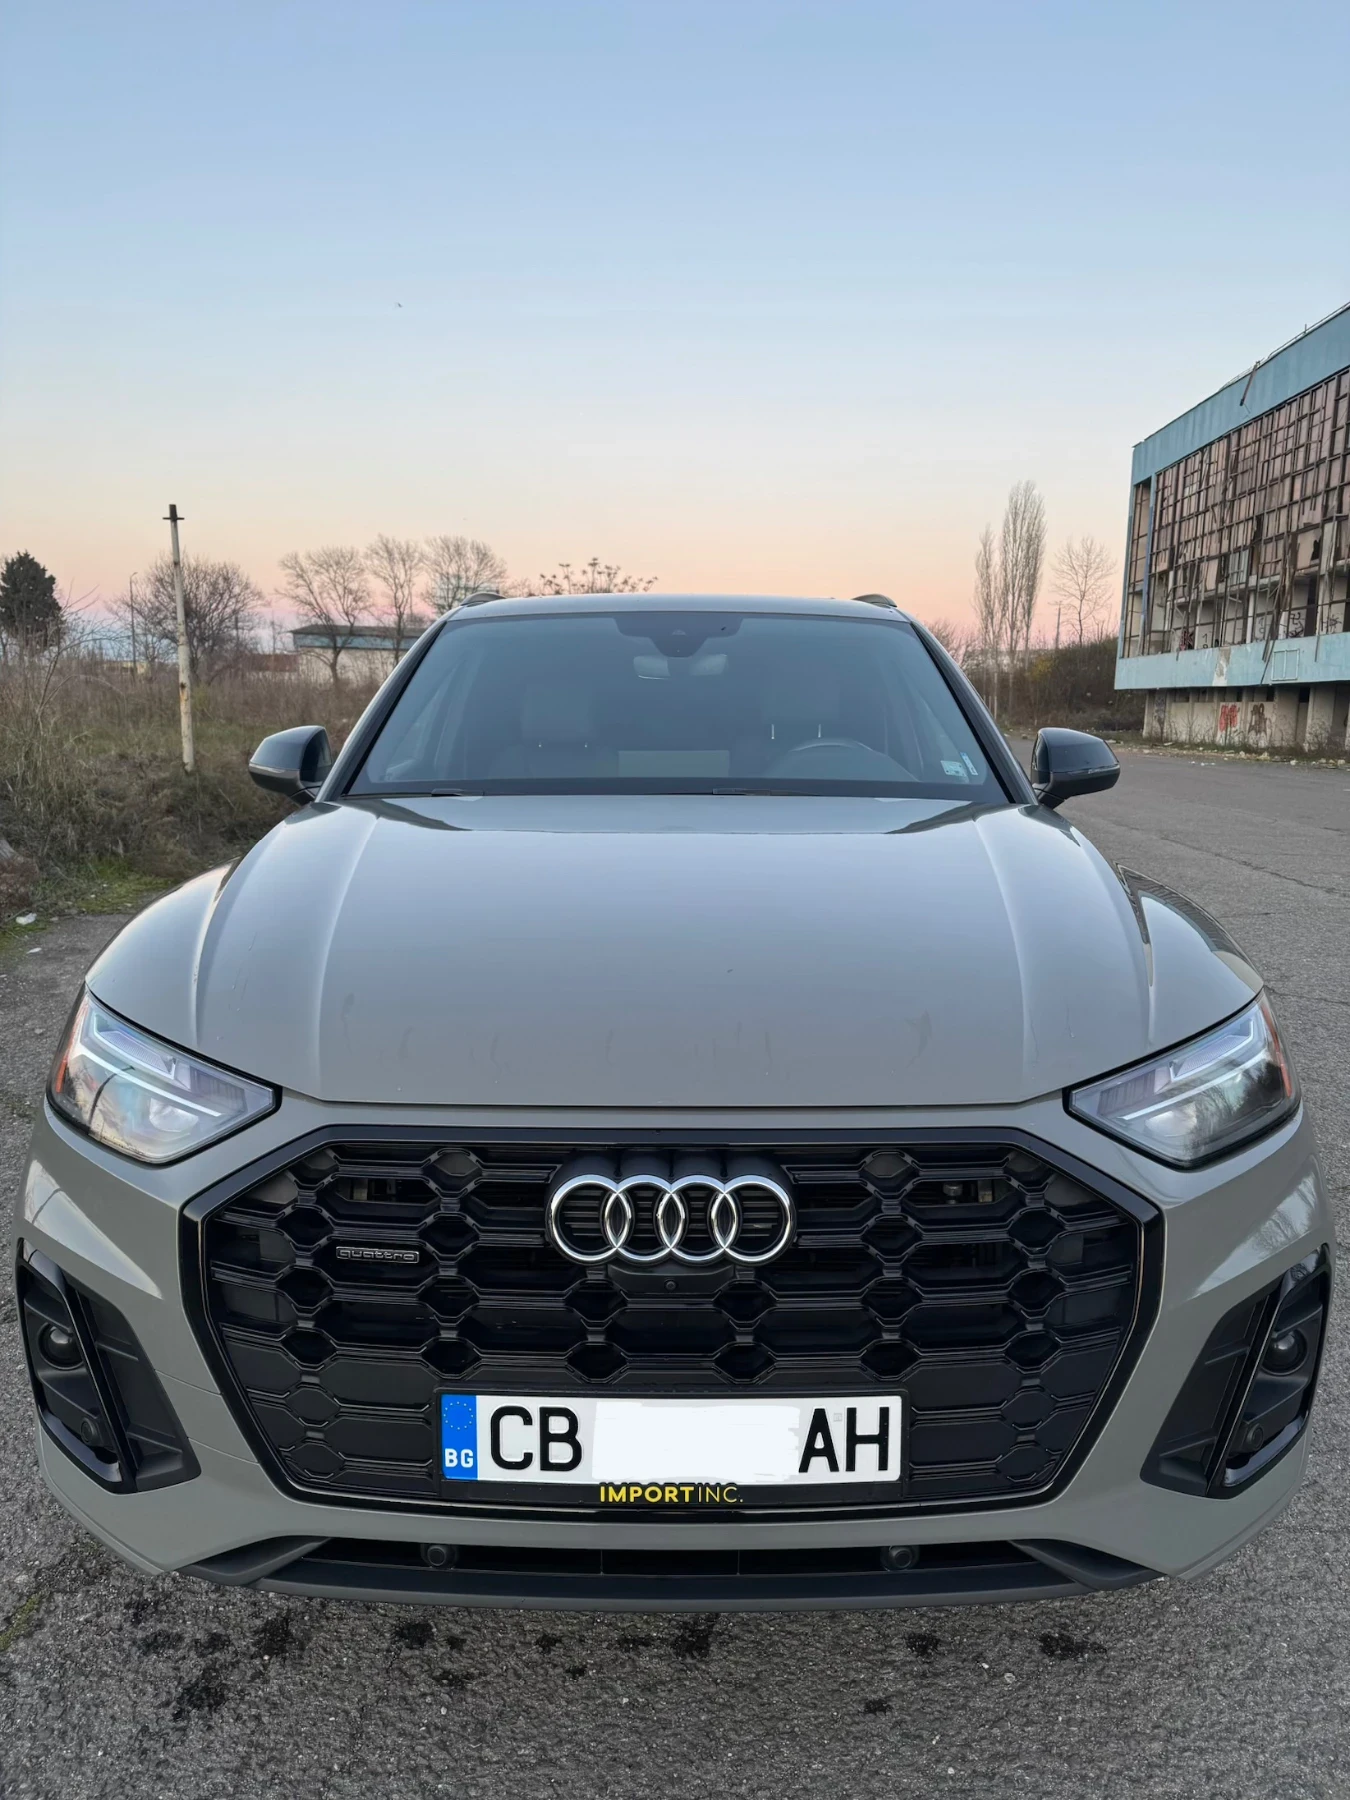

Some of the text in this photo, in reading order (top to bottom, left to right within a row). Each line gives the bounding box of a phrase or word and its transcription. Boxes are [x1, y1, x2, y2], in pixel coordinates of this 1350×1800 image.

[339, 1249, 415, 1260] quattro
[490, 1405, 890, 1473] CB AH
[444, 1448, 474, 1468] BG
